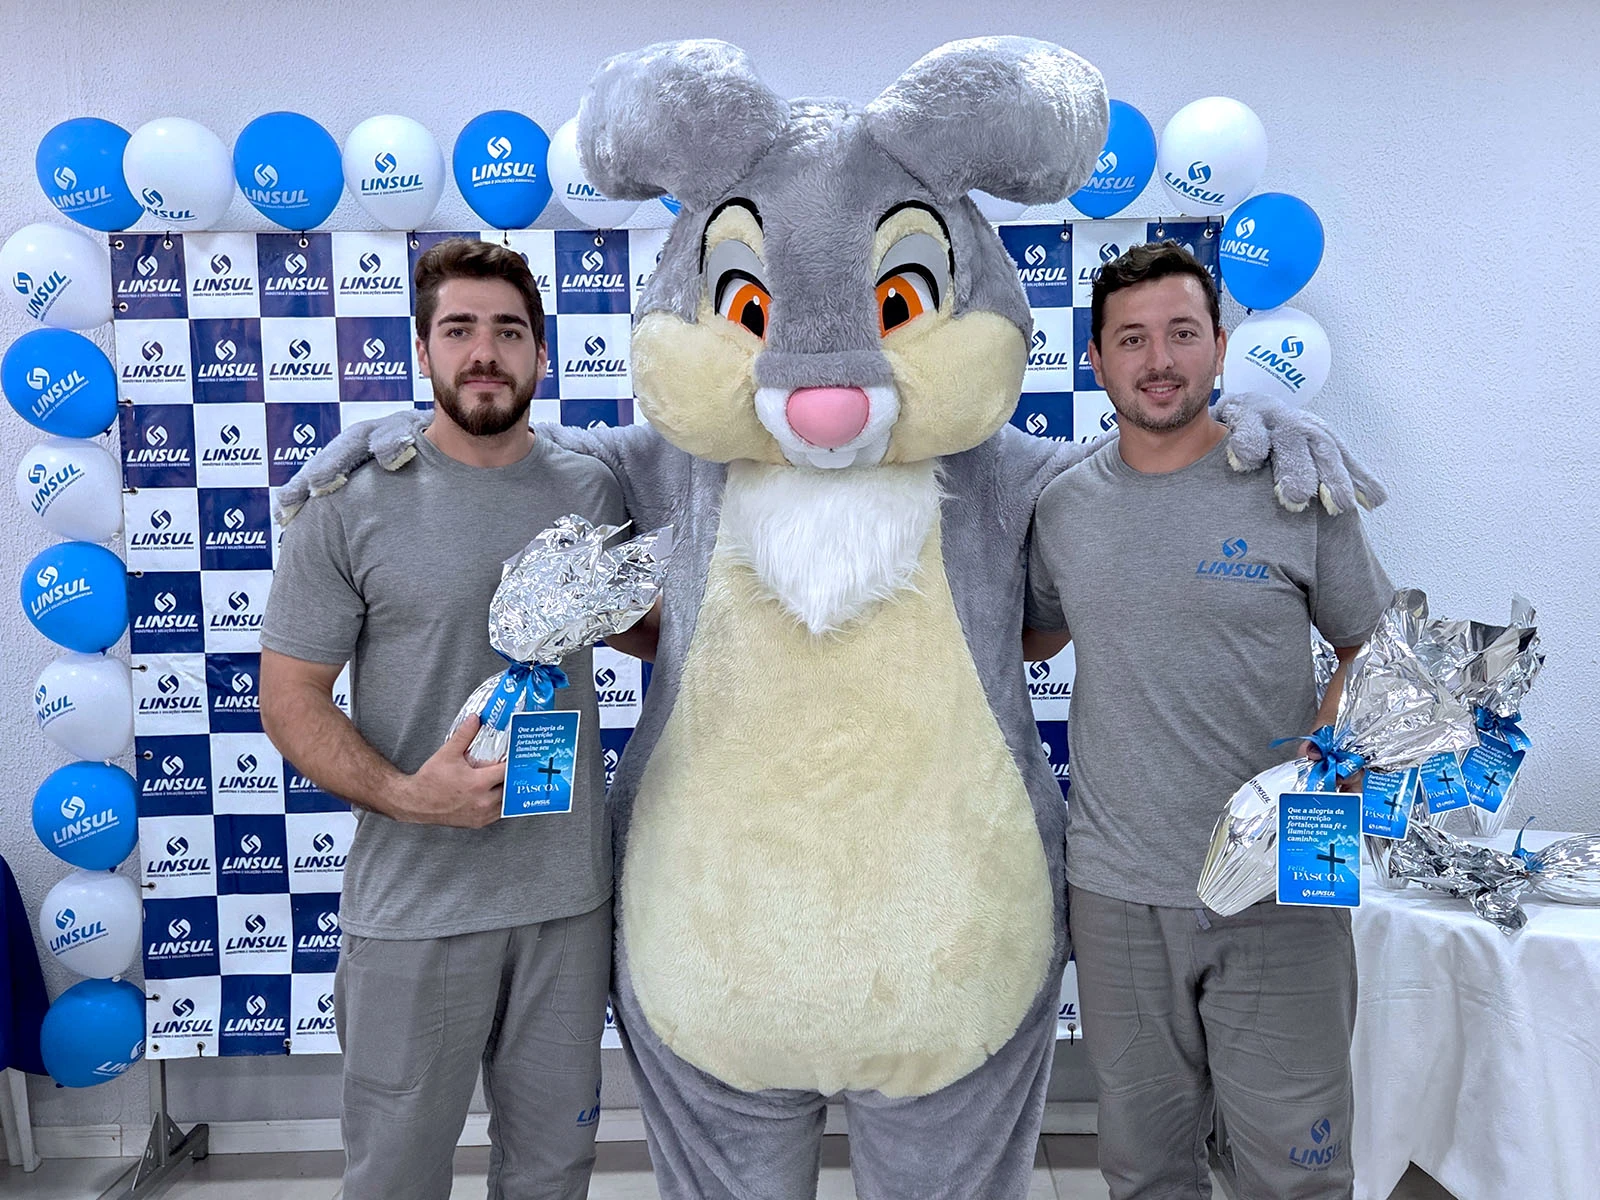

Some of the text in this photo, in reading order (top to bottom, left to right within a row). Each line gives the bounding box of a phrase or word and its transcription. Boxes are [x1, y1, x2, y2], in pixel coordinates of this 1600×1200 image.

[472, 162, 536, 182] LINSUL
[361, 174, 423, 191] LINSUL
[1087, 176, 1135, 189] NSUL
[1164, 172, 1225, 204] LINSUL
[245, 187, 308, 204] LINSUL
[566, 183, 601, 196] LIN
[52, 186, 111, 209] LINSUL
[1220, 239, 1270, 262] LINSUL
[561, 274, 624, 287] LINSUL
[1018, 268, 1067, 281] INSUL
[118, 280, 181, 292] LINSUL
[193, 278, 253, 291] LINSUL
[265, 278, 328, 290] LINSUL
[340, 277, 403, 290] LINSUL
[26, 271, 67, 319] LINSUL
[1028, 353, 1067, 365] NSUL
[122, 365, 186, 377] LINSUL
[198, 364, 258, 377] LINSUL
[270, 363, 332, 376] LINSUL
[344, 362, 407, 375] LINSUL
[565, 360, 627, 372] LINSUL
[1248, 345, 1306, 388] LINSUL
[32, 370, 85, 418] LINSUL
[126, 449, 190, 462] LINSUL
[202, 448, 262, 461] LINSUL
[274, 448, 323, 460] LINS
[31, 464, 80, 513] LINSUL
[131, 533, 194, 545] LINSUL
[206, 532, 266, 544] LINSUL
[1196, 560, 1269, 579] LINSUL
[30, 578, 91, 616] LINSUL
[134, 615, 198, 628] LINSUL
[210, 614, 263, 627] LINSU
[1028, 683, 1071, 695] NSUL
[139, 697, 202, 709] LINSUL
[142, 778, 207, 792] LINSUL
[219, 776, 278, 788] LINSUL
[517, 784, 559, 794] PÁSCOA
[1254, 782, 1271, 803] LINSUL
[1309, 807, 1333, 816] alegria
[53, 809, 119, 844] LINSUL
[147, 859, 210, 872] LINSUL
[222, 857, 283, 870] LINSUL
[294, 856, 347, 868] LINSU
[1294, 871, 1345, 882] PÁSCOA
[50, 921, 107, 952] LINSUL
[225, 936, 287, 950] LINSUL
[298, 935, 342, 948] LINS
[148, 940, 214, 955] LINSUL
[152, 1020, 213, 1034] LINSUL
[225, 1018, 285, 1032] LINSUL
[296, 1017, 336, 1030] LINS
